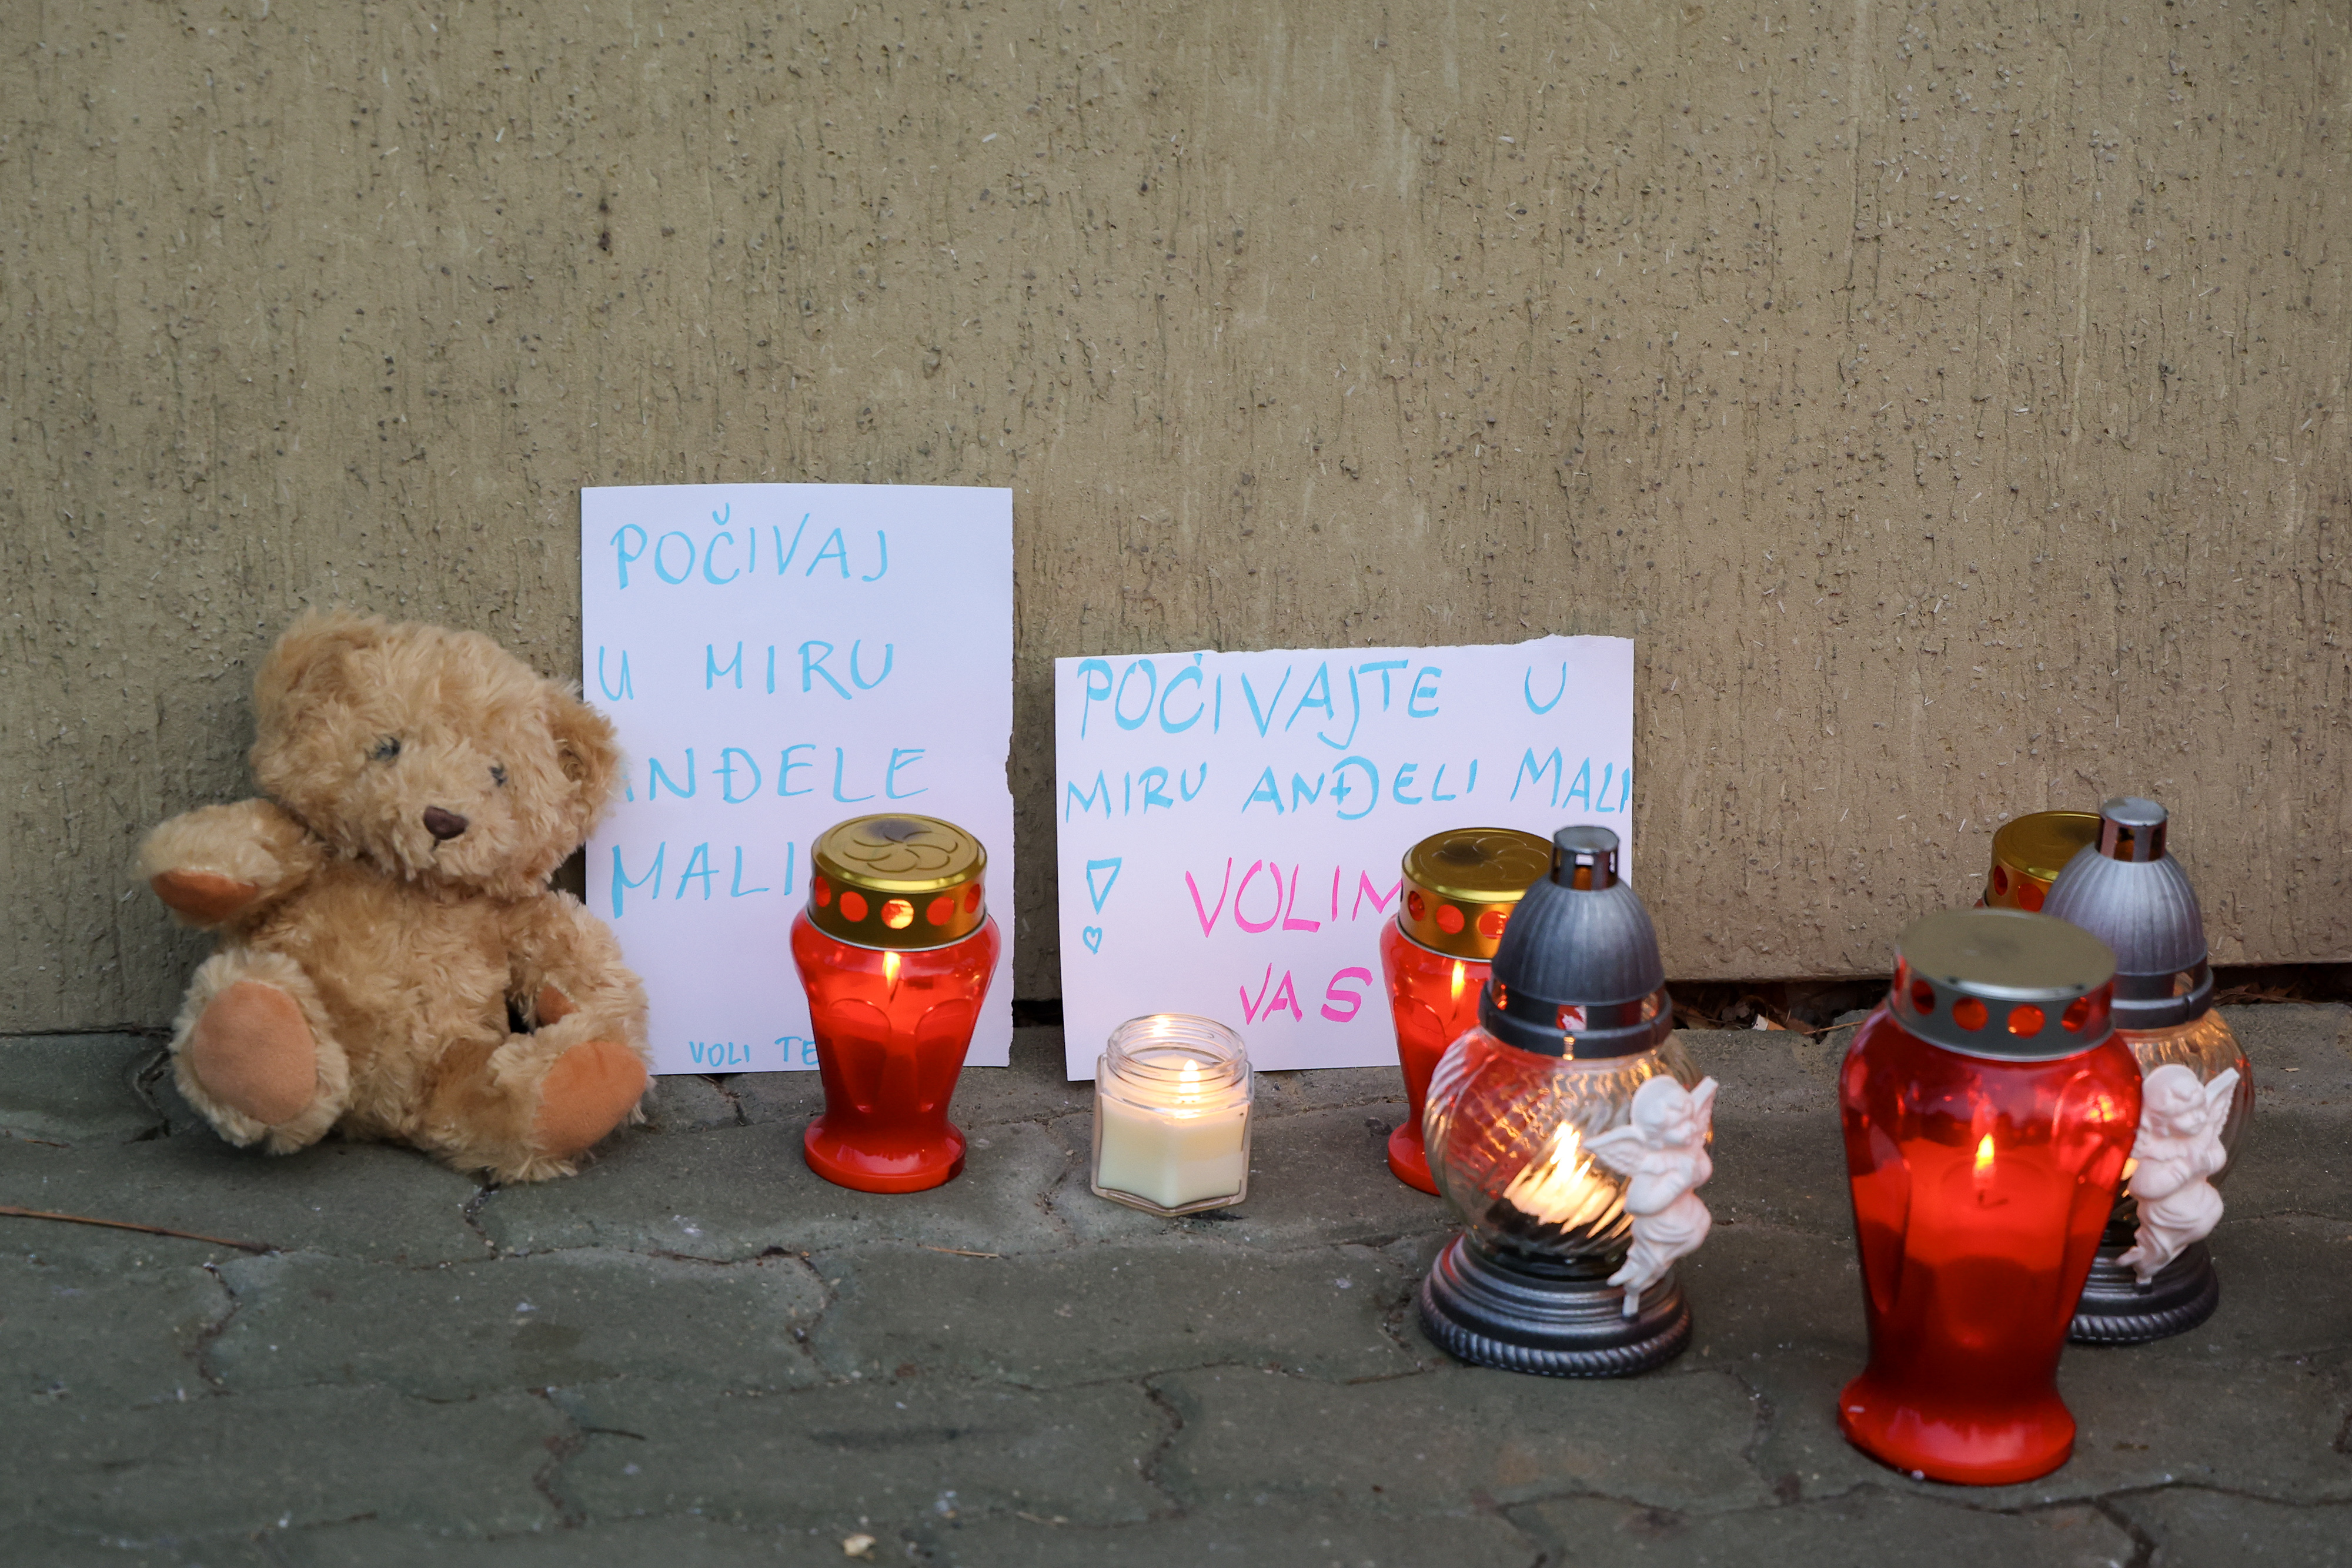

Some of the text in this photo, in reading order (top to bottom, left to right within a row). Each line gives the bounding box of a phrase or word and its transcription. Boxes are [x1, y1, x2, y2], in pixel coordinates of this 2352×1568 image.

[610, 502, 888, 590] POČIVAJ
[599, 639, 894, 702] U MIRU
[1524, 661, 1567, 716] U
[1065, 747, 1631, 823] MIRU ANĐELI MALI
[611, 841, 795, 920] MALI
[1240, 962, 1374, 1025] VAS
[689, 1040, 750, 1067] VOLI
